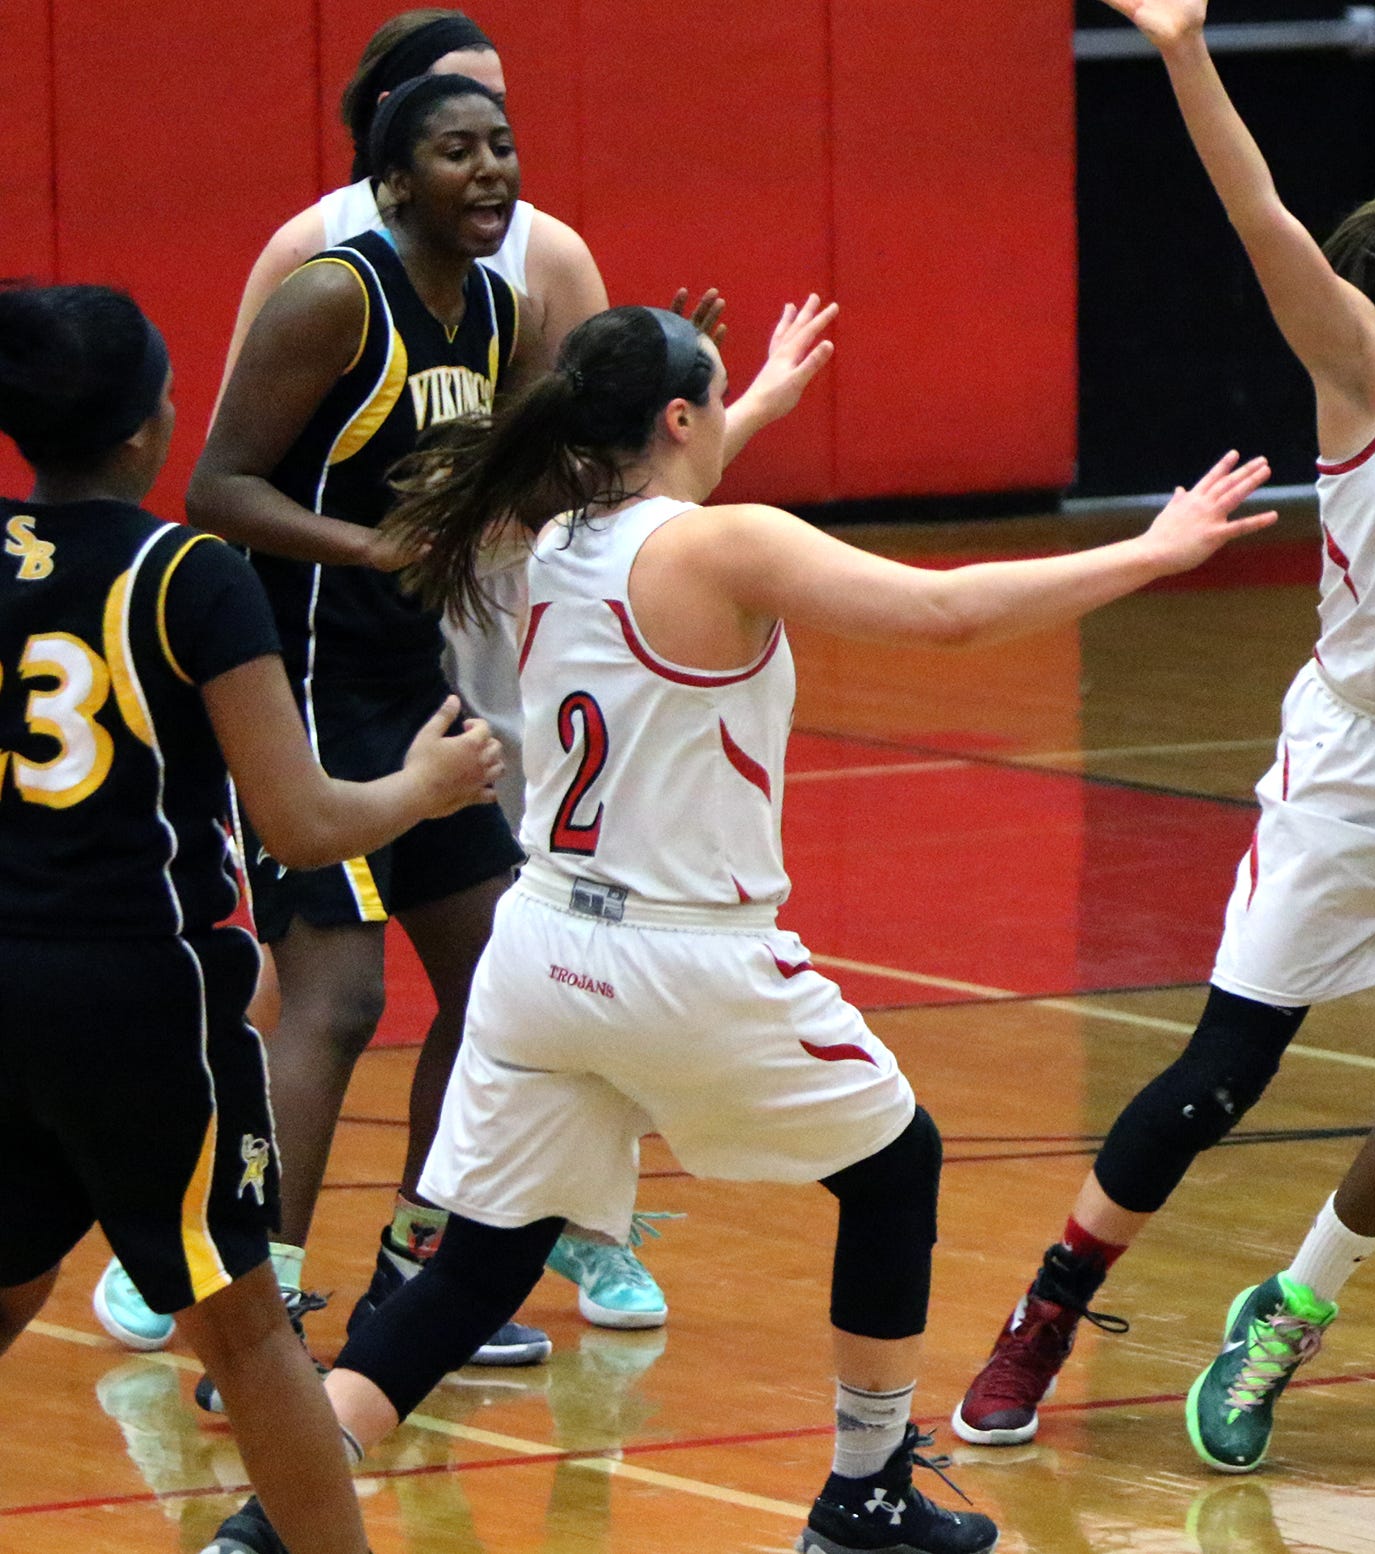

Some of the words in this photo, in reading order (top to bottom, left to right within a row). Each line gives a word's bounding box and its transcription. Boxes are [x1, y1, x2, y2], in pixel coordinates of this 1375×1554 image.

[0, 630, 115, 810] 3
[549, 690, 610, 857] 2
[549, 963, 616, 1000] TROJANS
